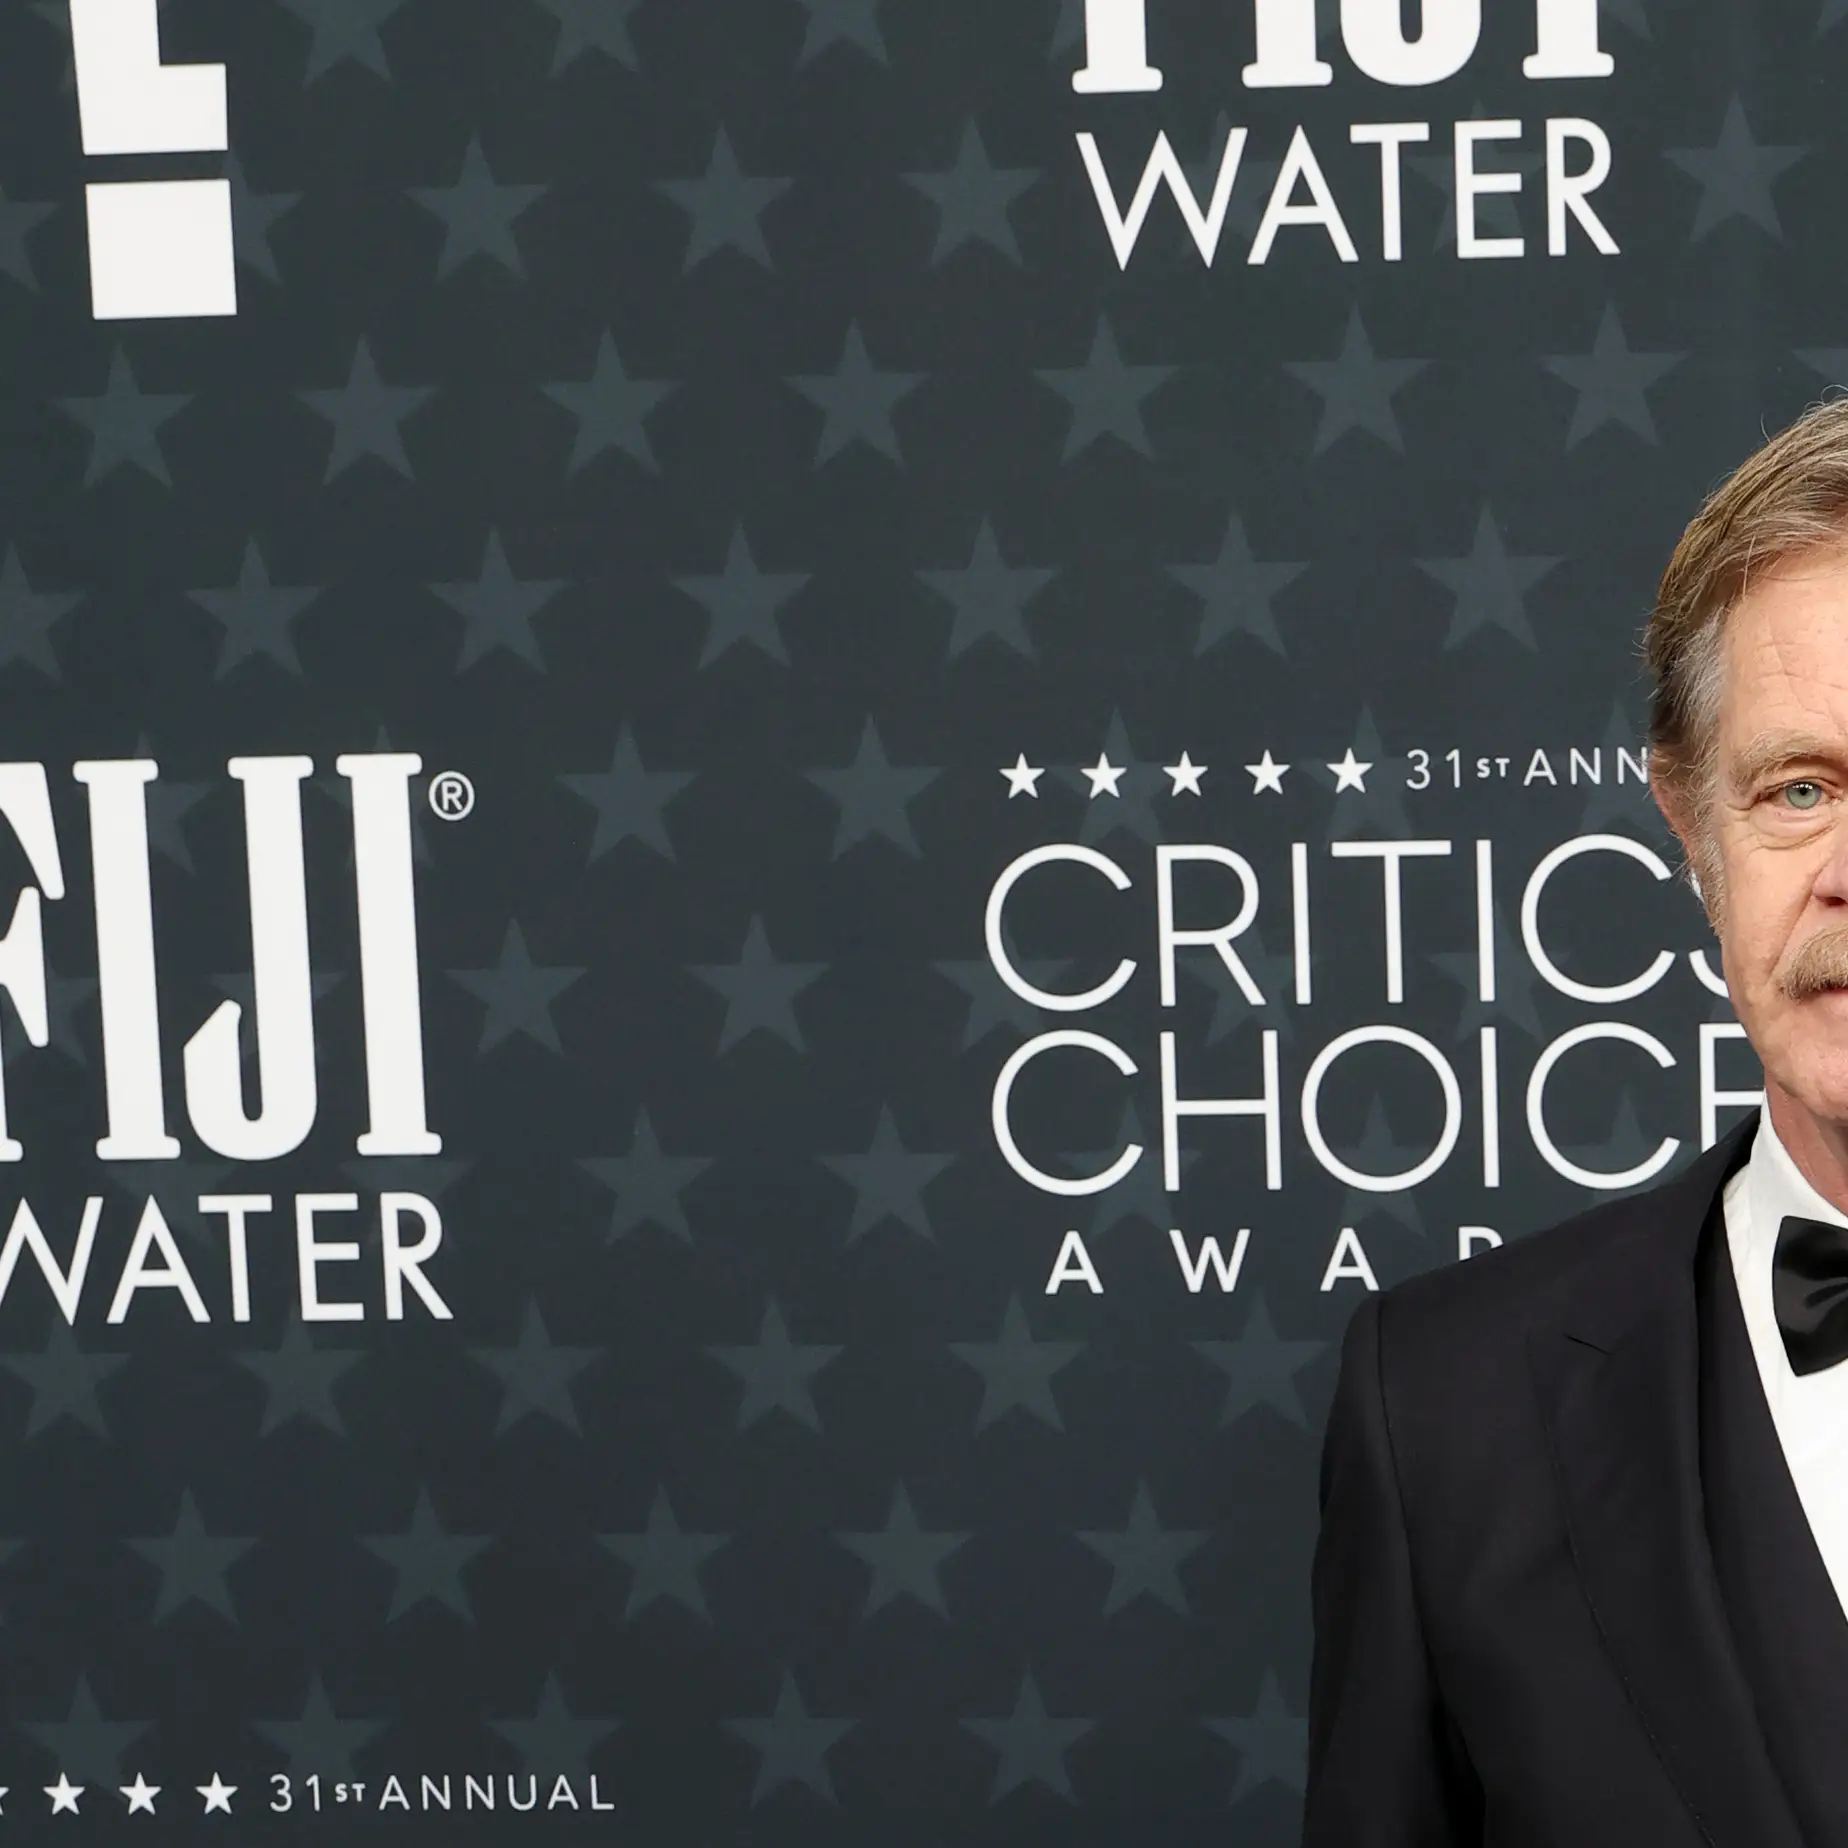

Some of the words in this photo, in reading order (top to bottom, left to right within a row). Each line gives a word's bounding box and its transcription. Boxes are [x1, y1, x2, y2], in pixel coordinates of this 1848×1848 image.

[1076, 117, 1620, 272] WATER
[984, 833, 1728, 1012] CRITIC
[378, 1774, 615, 1811] ANNUAL
